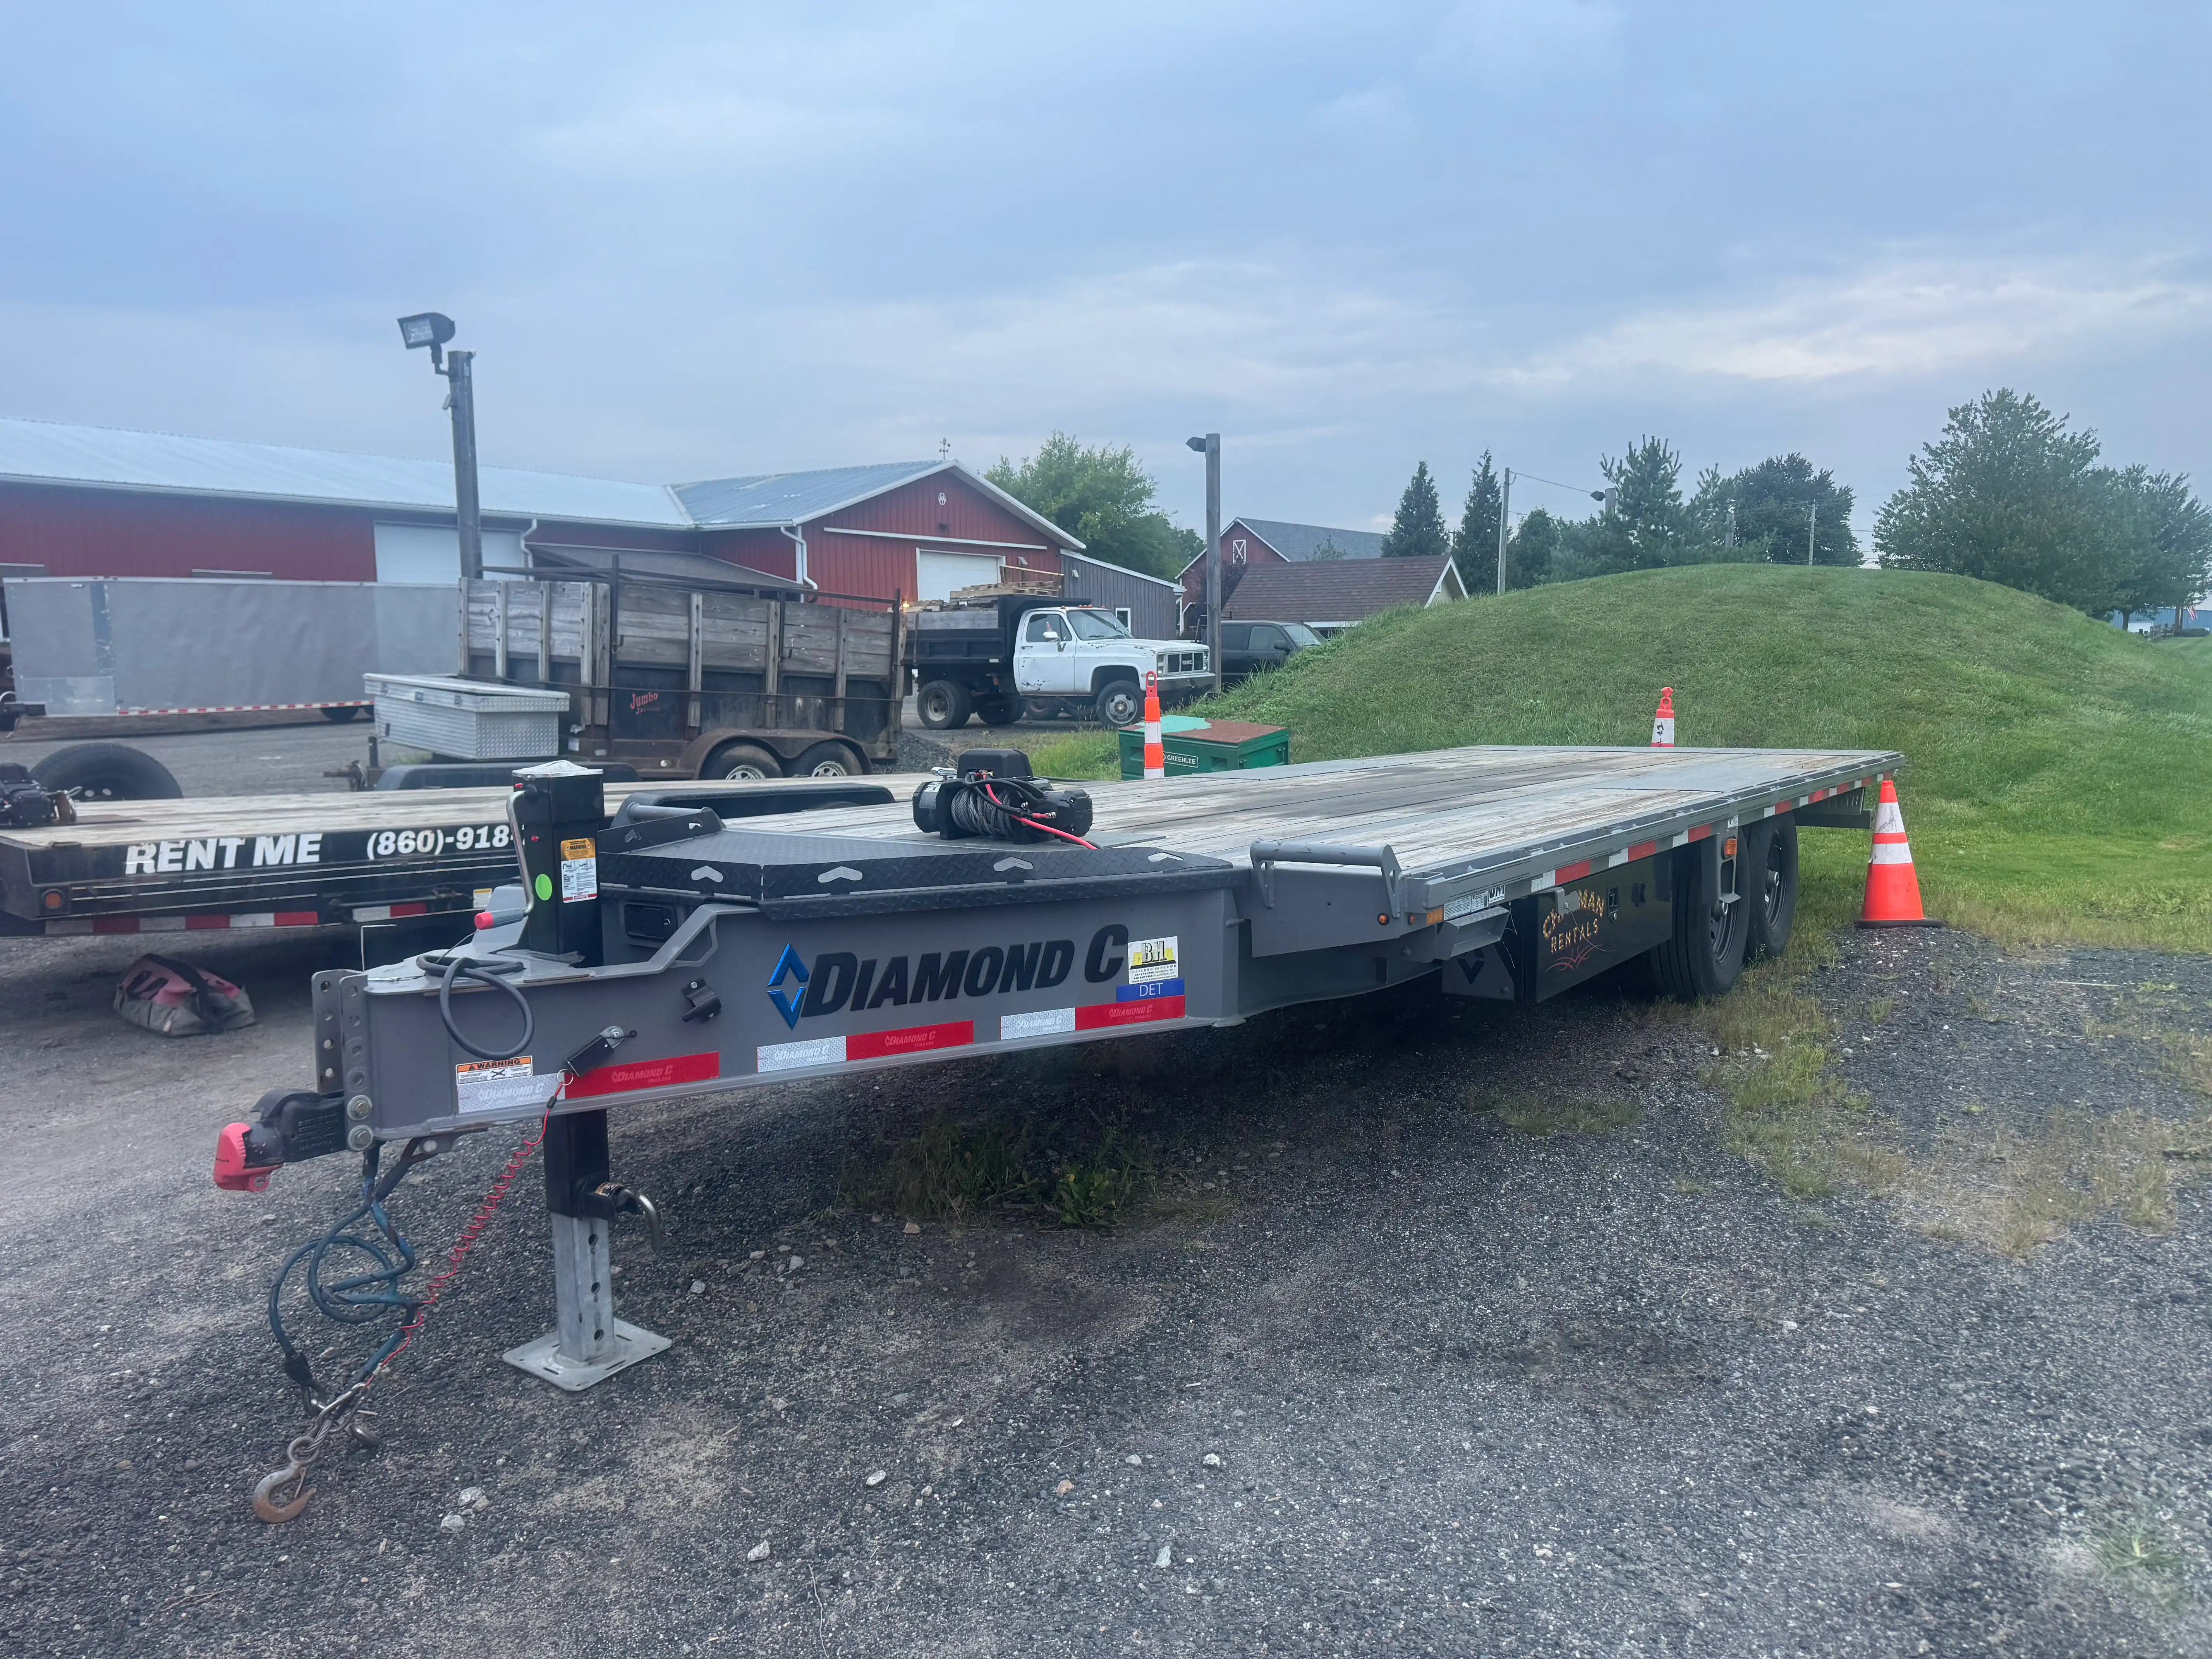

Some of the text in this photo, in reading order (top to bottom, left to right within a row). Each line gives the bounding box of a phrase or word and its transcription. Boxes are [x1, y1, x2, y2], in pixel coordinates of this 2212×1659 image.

[630, 691, 658, 710] Jumbo
[1167, 755, 1196, 764] GREENLEE
[125, 833, 322, 875] RENT ME
[1543, 890, 1605, 940] CHMAN
[1551, 918, 1599, 954] RENTALS
[800, 924, 1128, 1017] DIAMOND C
[1139, 982, 1163, 997] DET
[1113, 1004, 1153, 1017] DIAMOND C
[889, 1031, 936, 1046] DIAMOND C
[477, 1059, 521, 1069] WARNING
[617, 1065, 673, 1082] DIAMOND C
